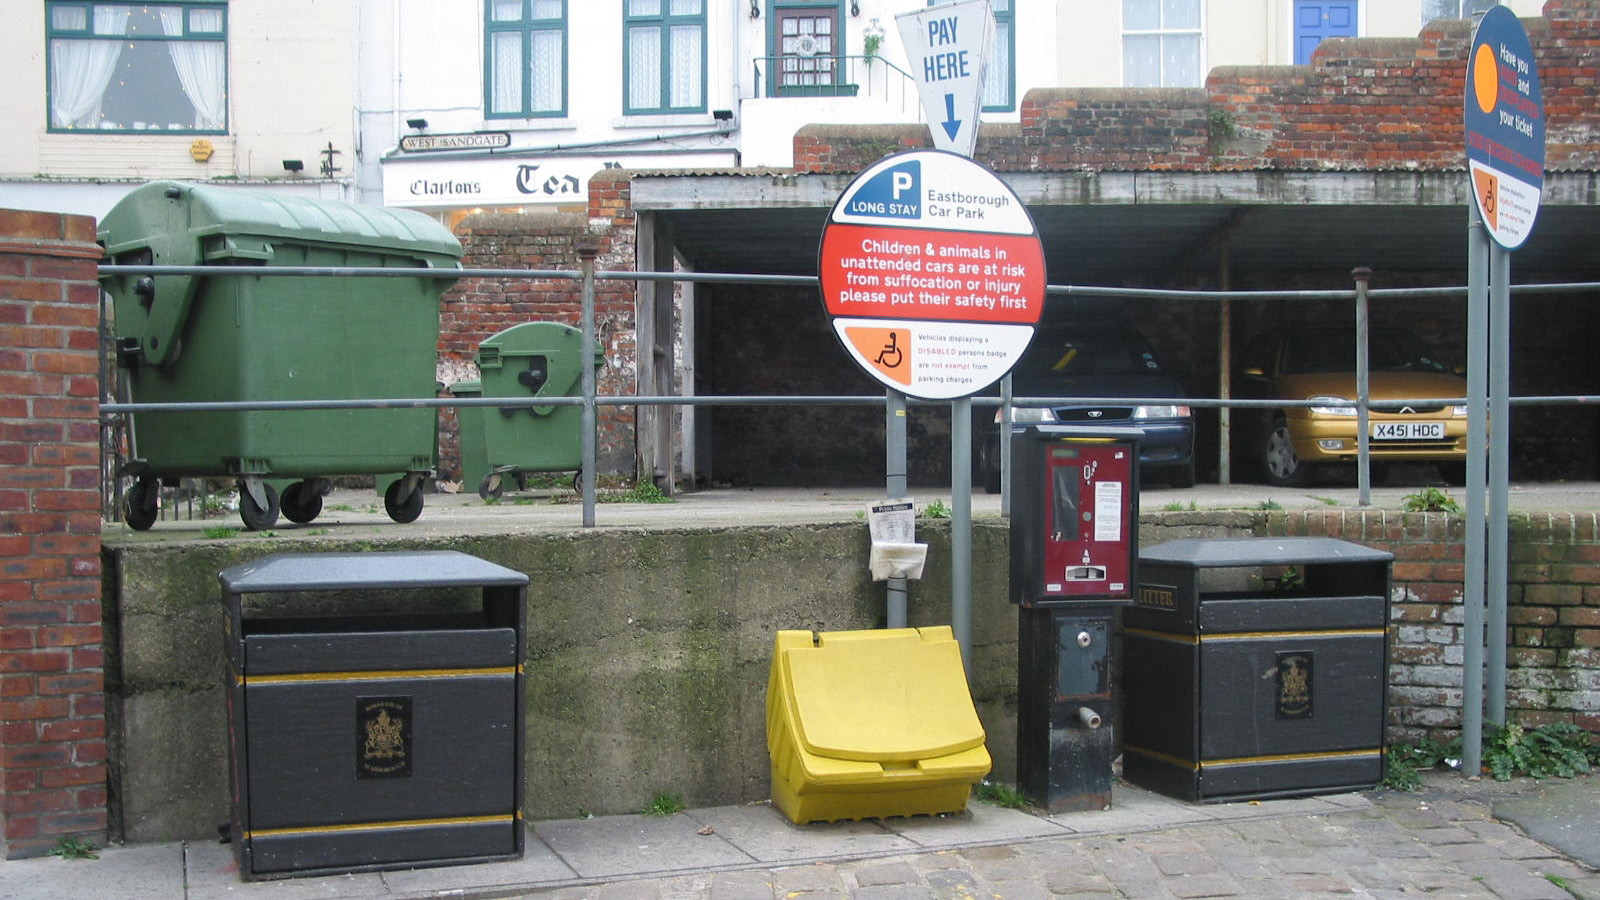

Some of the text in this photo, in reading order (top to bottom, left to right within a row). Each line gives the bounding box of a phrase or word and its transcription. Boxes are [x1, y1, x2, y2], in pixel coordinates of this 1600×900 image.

[928, 16, 958, 47] PAY
[924, 50, 970, 82] HERE
[1500, 42, 1528, 74] Have you
[1518, 78, 1530, 96] and
[1500, 109, 1533, 138] your ticket
[406, 135, 504, 148] WEST SANDGATE
[410, 180, 481, 196] Clayton's
[516, 164, 580, 196] Tea
[892, 172, 912, 200] P
[928, 190, 1009, 208] Eastborough
[852, 202, 918, 216] LONG STAY
[928, 205, 984, 220] Car Park
[862, 239, 1007, 260] Children & animals in
[840, 256, 1026, 277] unattended cars are at risk
[846, 272, 1022, 294] from suffocation or injury
[840, 289, 1028, 310] please put their safety first
[948, 336, 982, 344] displaying
[918, 348, 1007, 358] DISABLED persons badge
[918, 376, 944, 384] parking
[1377, 424, 1440, 437] X451 HDC
[1138, 588, 1174, 606] LITTER
